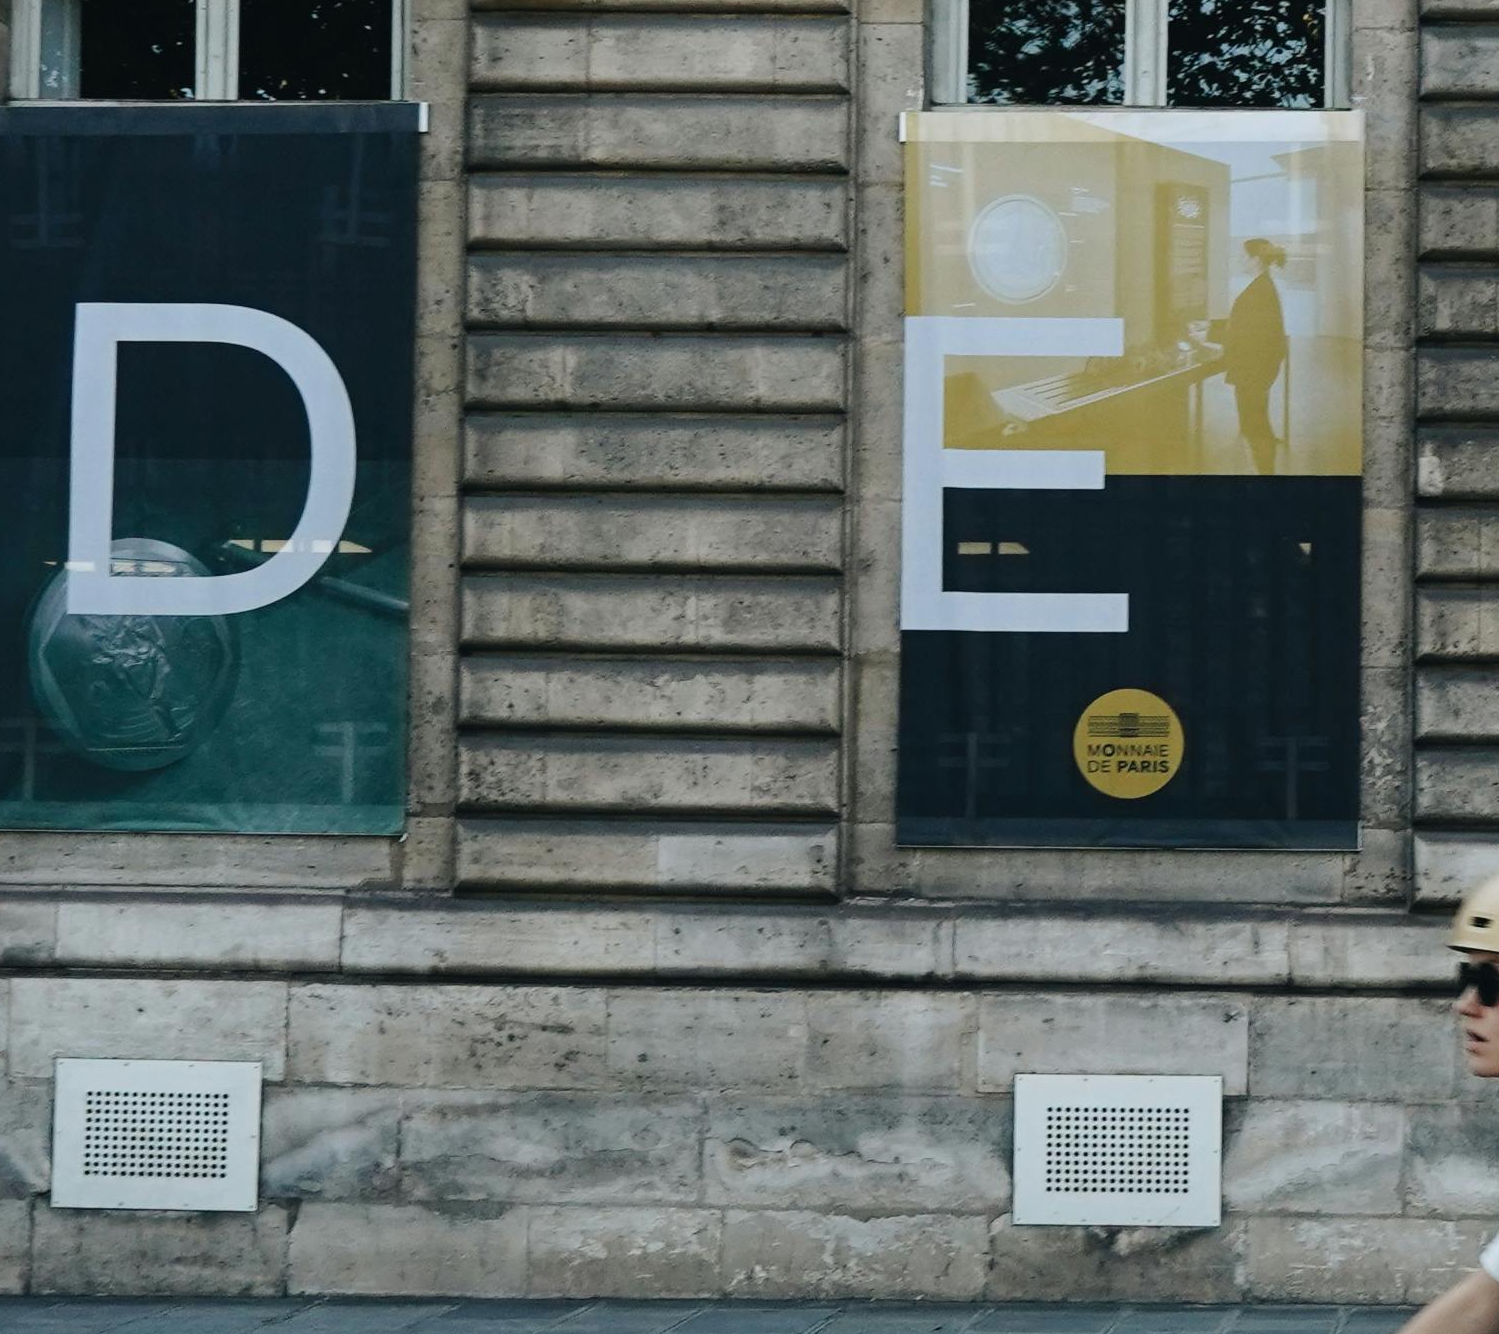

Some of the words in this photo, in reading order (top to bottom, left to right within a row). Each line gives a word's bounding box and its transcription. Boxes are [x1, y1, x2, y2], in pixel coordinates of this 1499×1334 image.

[66, 302, 357, 616] D
[900, 316, 1129, 633] E
[1087, 744, 1169, 757] MONNAIE
[1087, 760, 1111, 773] DE
[1117, 760, 1170, 773] PARIS
